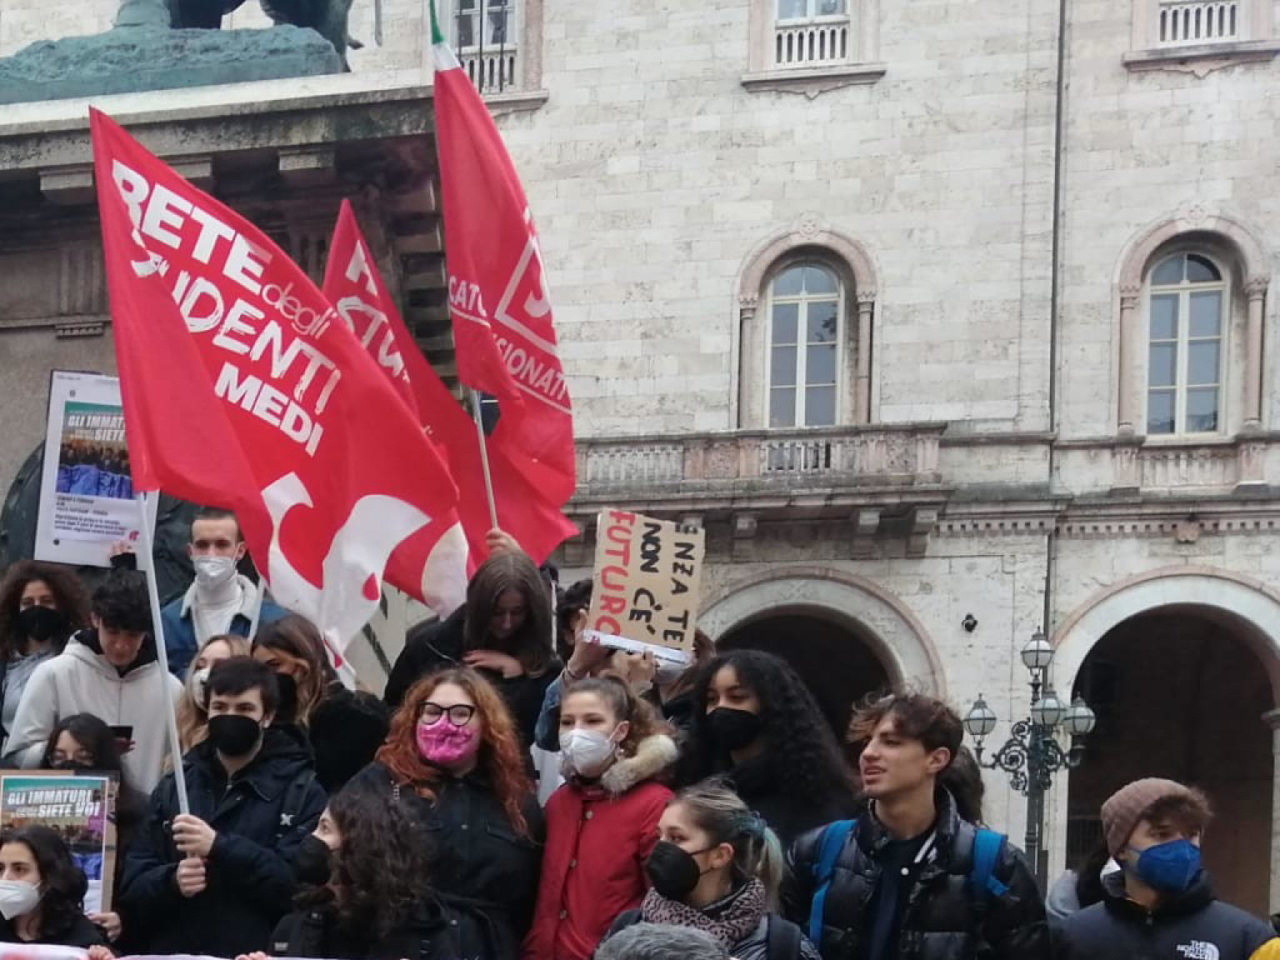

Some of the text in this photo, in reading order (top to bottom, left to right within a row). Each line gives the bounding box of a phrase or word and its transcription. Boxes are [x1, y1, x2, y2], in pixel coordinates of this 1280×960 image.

[111, 159, 273, 297] RETE
[261, 281, 339, 340] degli
[213, 361, 324, 458] MEDI
[639, 522, 663, 573] NON
[662, 609, 689, 648] TE
[7, 791, 26, 806] GLI
[27, 789, 93, 805] IMMATURI
[38, 804, 73, 818] SIETE
